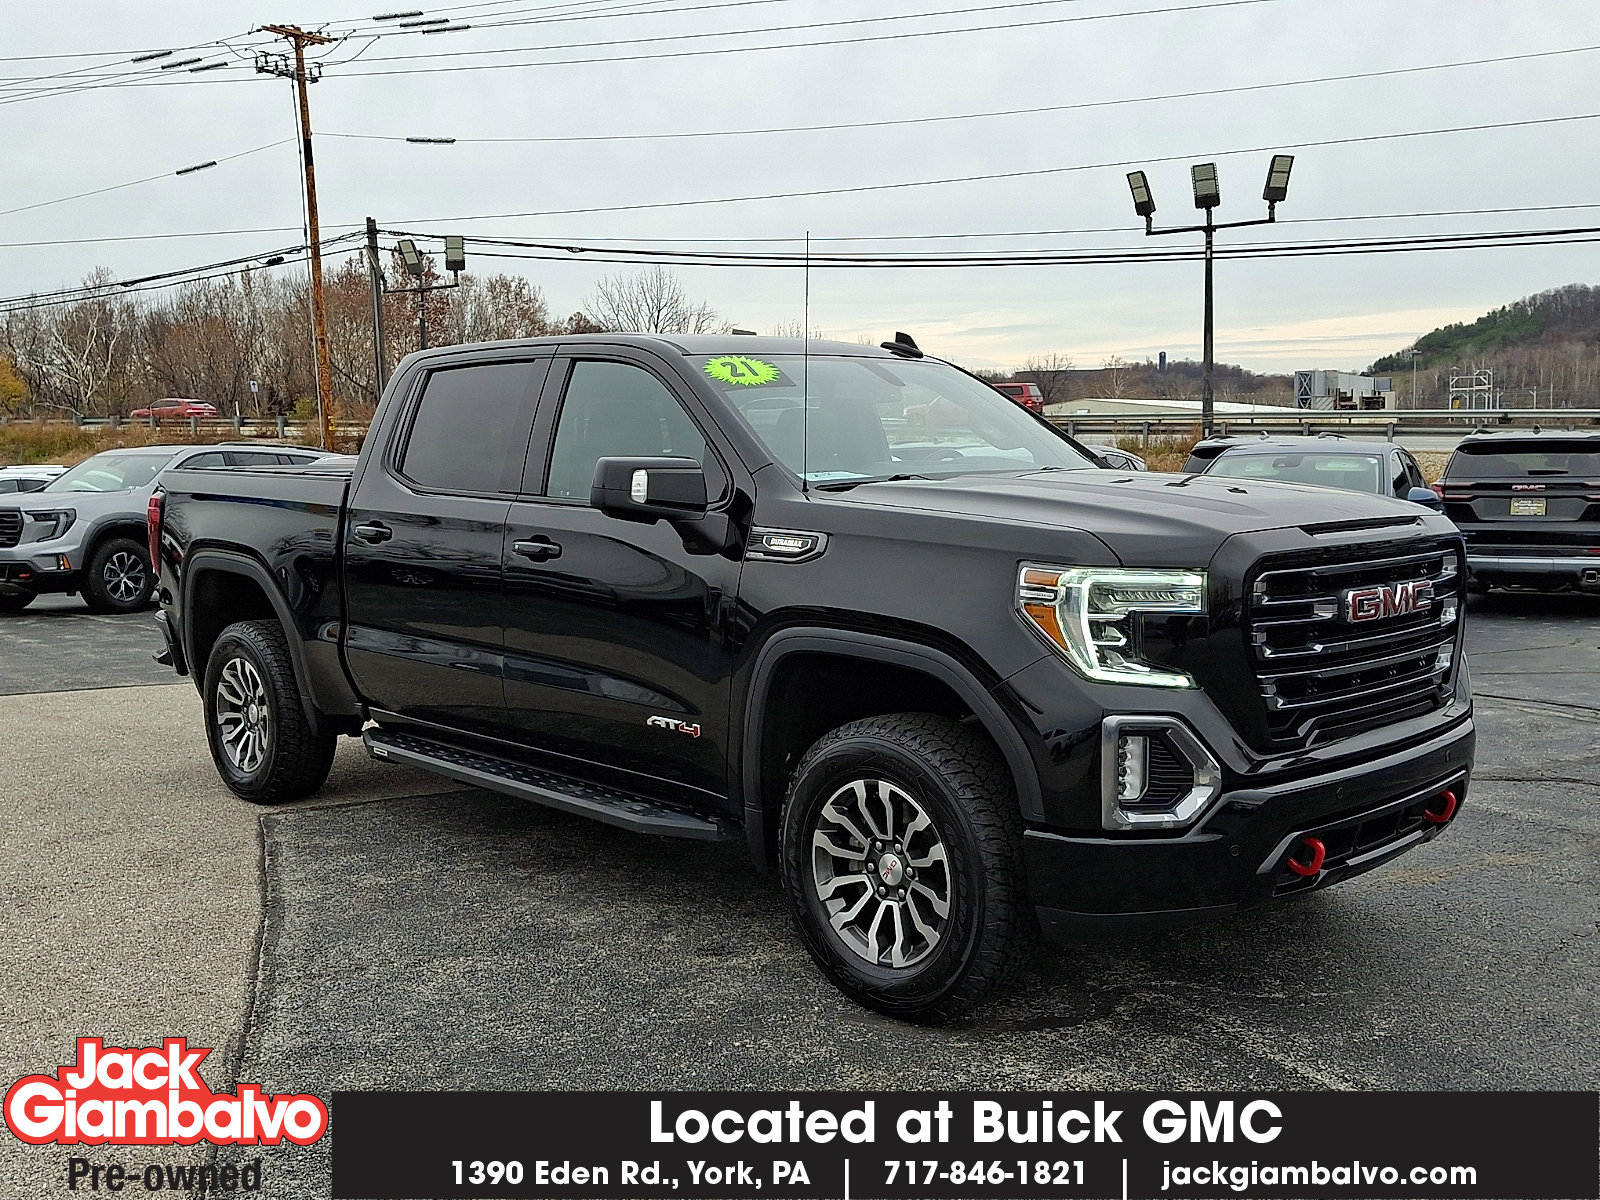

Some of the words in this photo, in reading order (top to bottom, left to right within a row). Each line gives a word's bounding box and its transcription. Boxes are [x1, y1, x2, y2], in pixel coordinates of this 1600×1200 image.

[720, 361, 759, 378] 21
[1347, 580, 1432, 623] GMC
[646, 715, 701, 738] AT4
